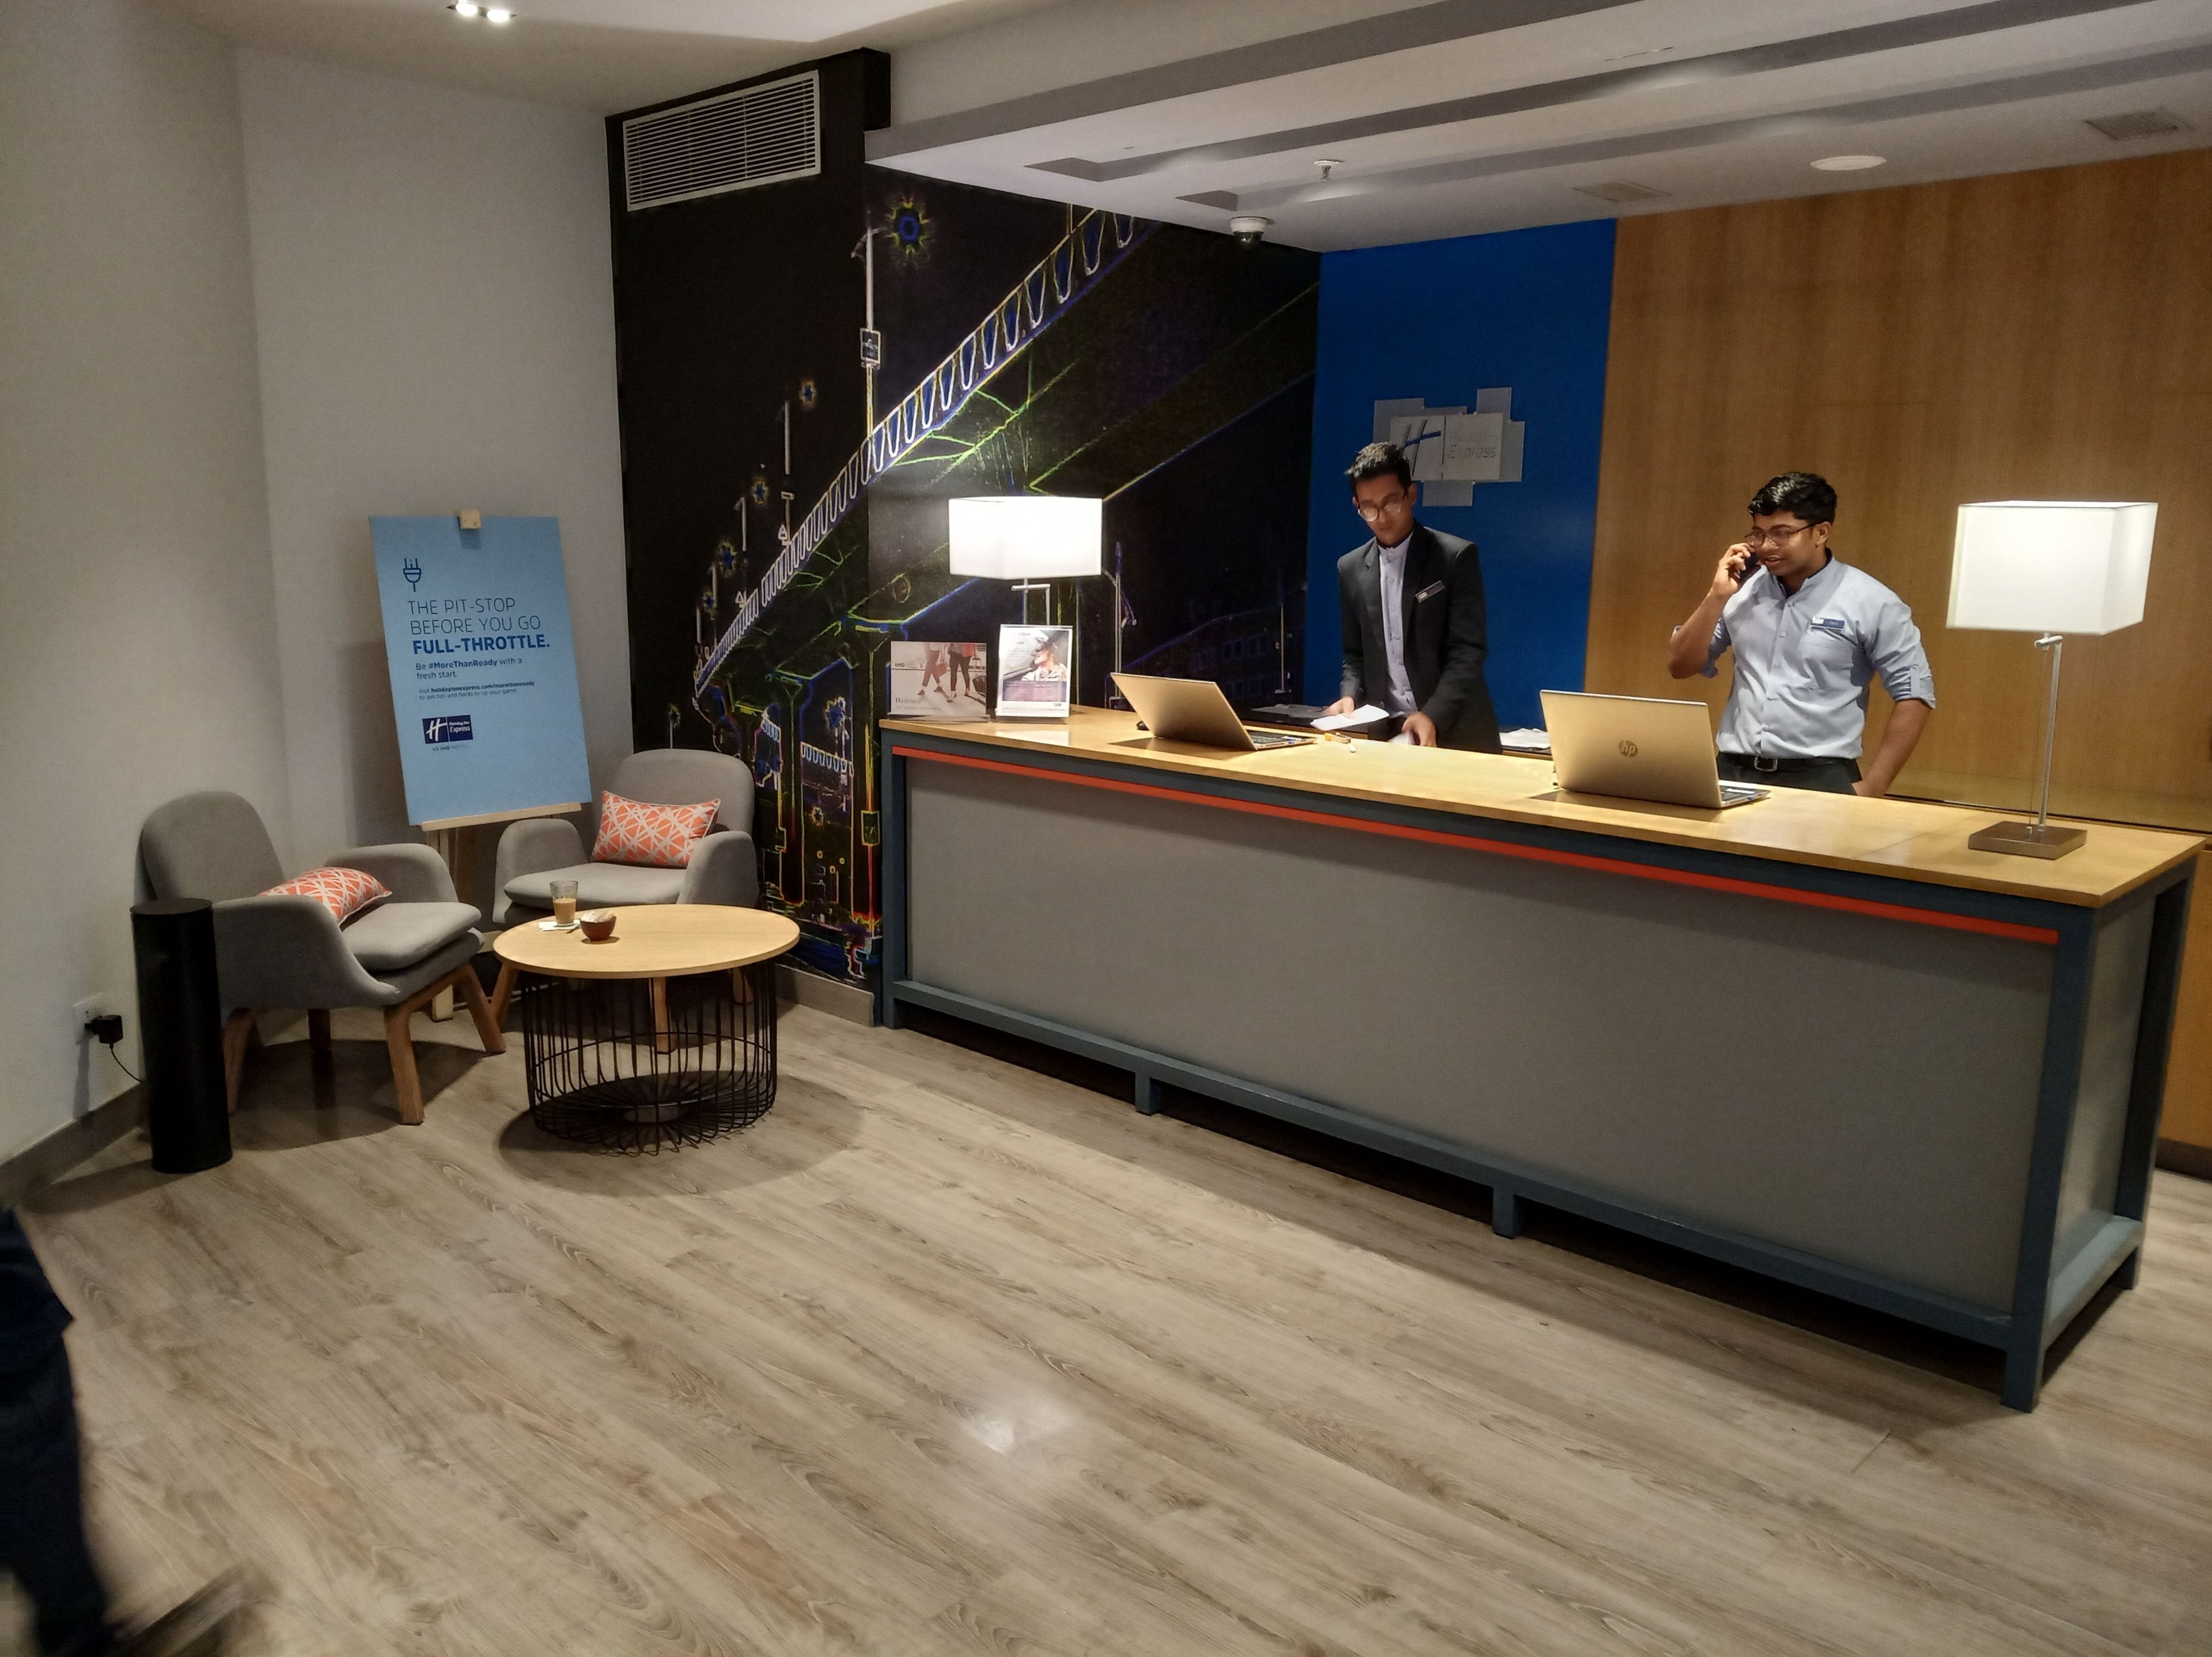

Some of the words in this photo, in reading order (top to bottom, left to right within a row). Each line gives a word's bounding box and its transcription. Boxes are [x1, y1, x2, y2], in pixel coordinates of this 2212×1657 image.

[408, 600, 438, 615] THE
[444, 597, 516, 613] PIT-STOP
[410, 618, 474, 635] BEFORE
[478, 617, 512, 631] YOU
[518, 615, 540, 630] GO
[412, 634, 550, 655] FULL-THROTTLE.
[428, 659, 498, 669] #MoreThanReady
[1621, 741, 1636, 758] hp
